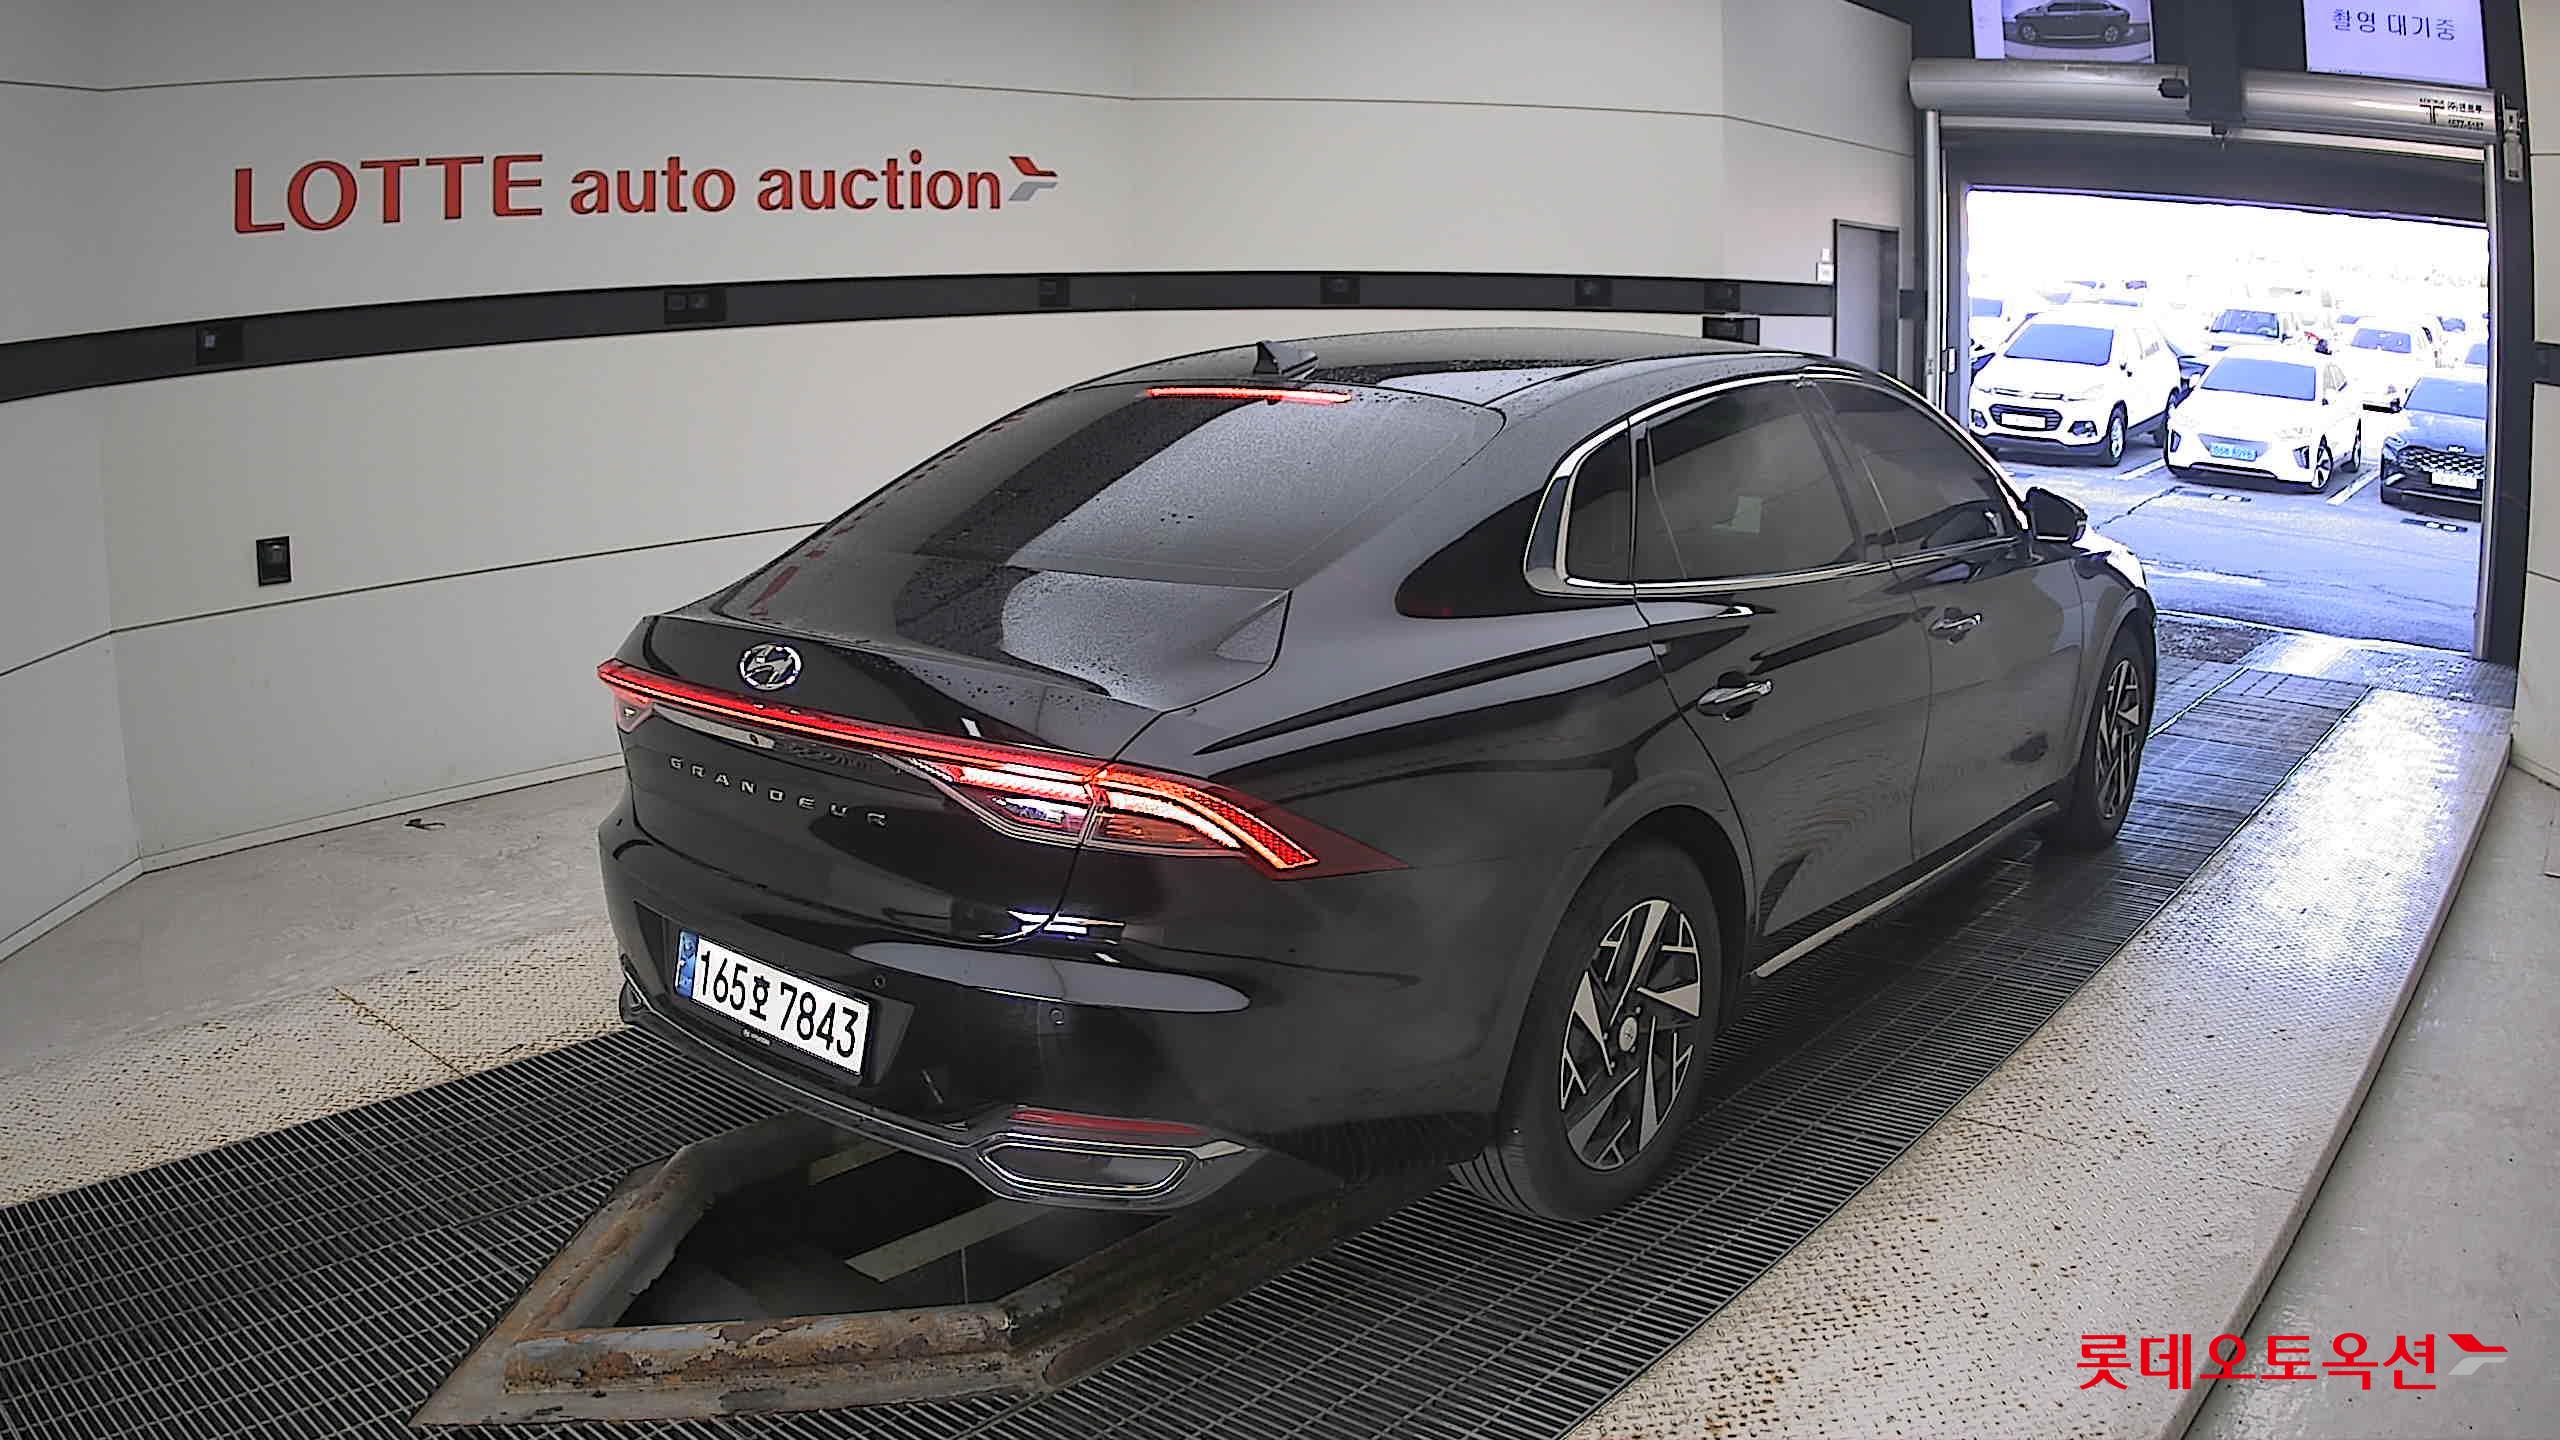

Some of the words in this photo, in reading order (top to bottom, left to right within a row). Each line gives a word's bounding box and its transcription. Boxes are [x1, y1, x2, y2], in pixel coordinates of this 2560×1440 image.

[2387, 14, 2456, 41] 대기중
[234, 153, 543, 234] LOTTE
[570, 155, 736, 215] auto
[756, 148, 1002, 211] auction
[669, 756, 888, 827] GRANDEUR
[700, 950, 771, 1021] 165호
[779, 981, 859, 1058] 7843
